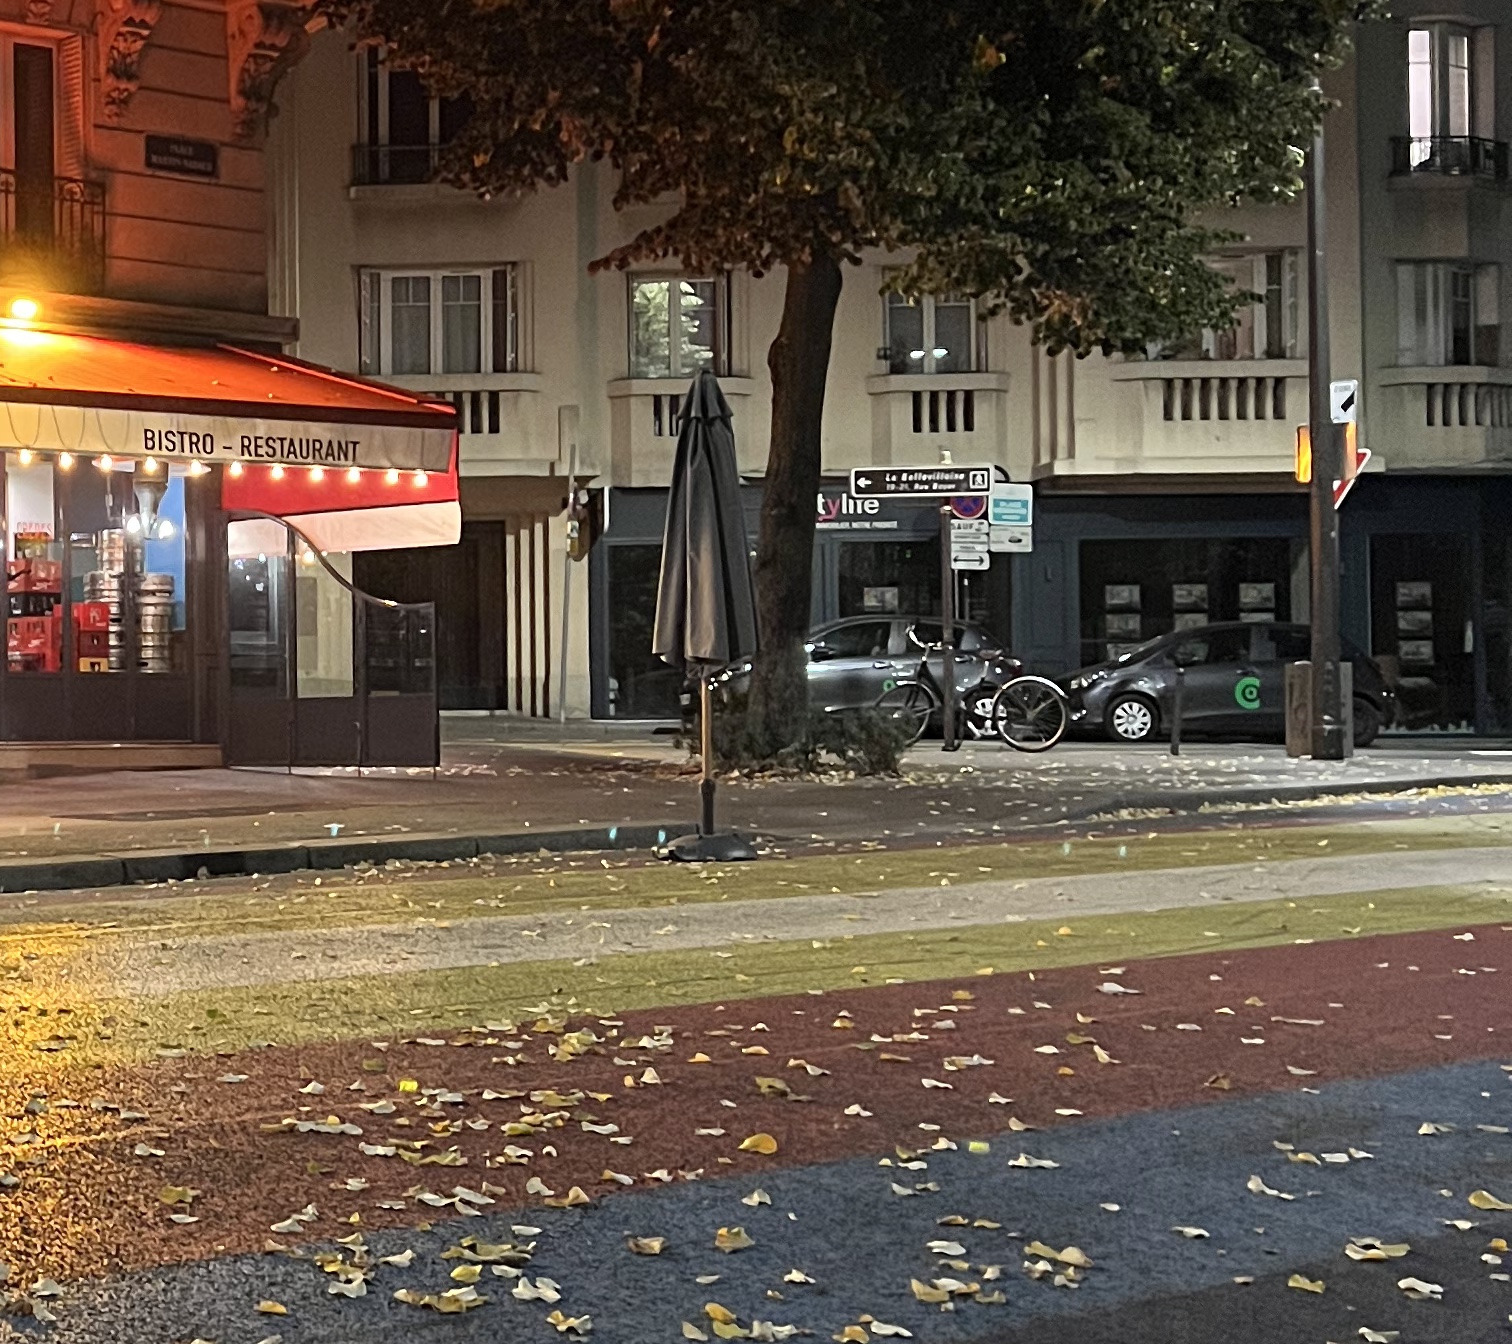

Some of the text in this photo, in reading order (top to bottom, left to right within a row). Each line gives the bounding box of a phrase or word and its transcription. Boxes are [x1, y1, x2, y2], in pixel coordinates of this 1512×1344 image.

[144, 428, 214, 455] BISTRO
[240, 434, 360, 462] RESTAURANT
[885, 472, 897, 482] La
